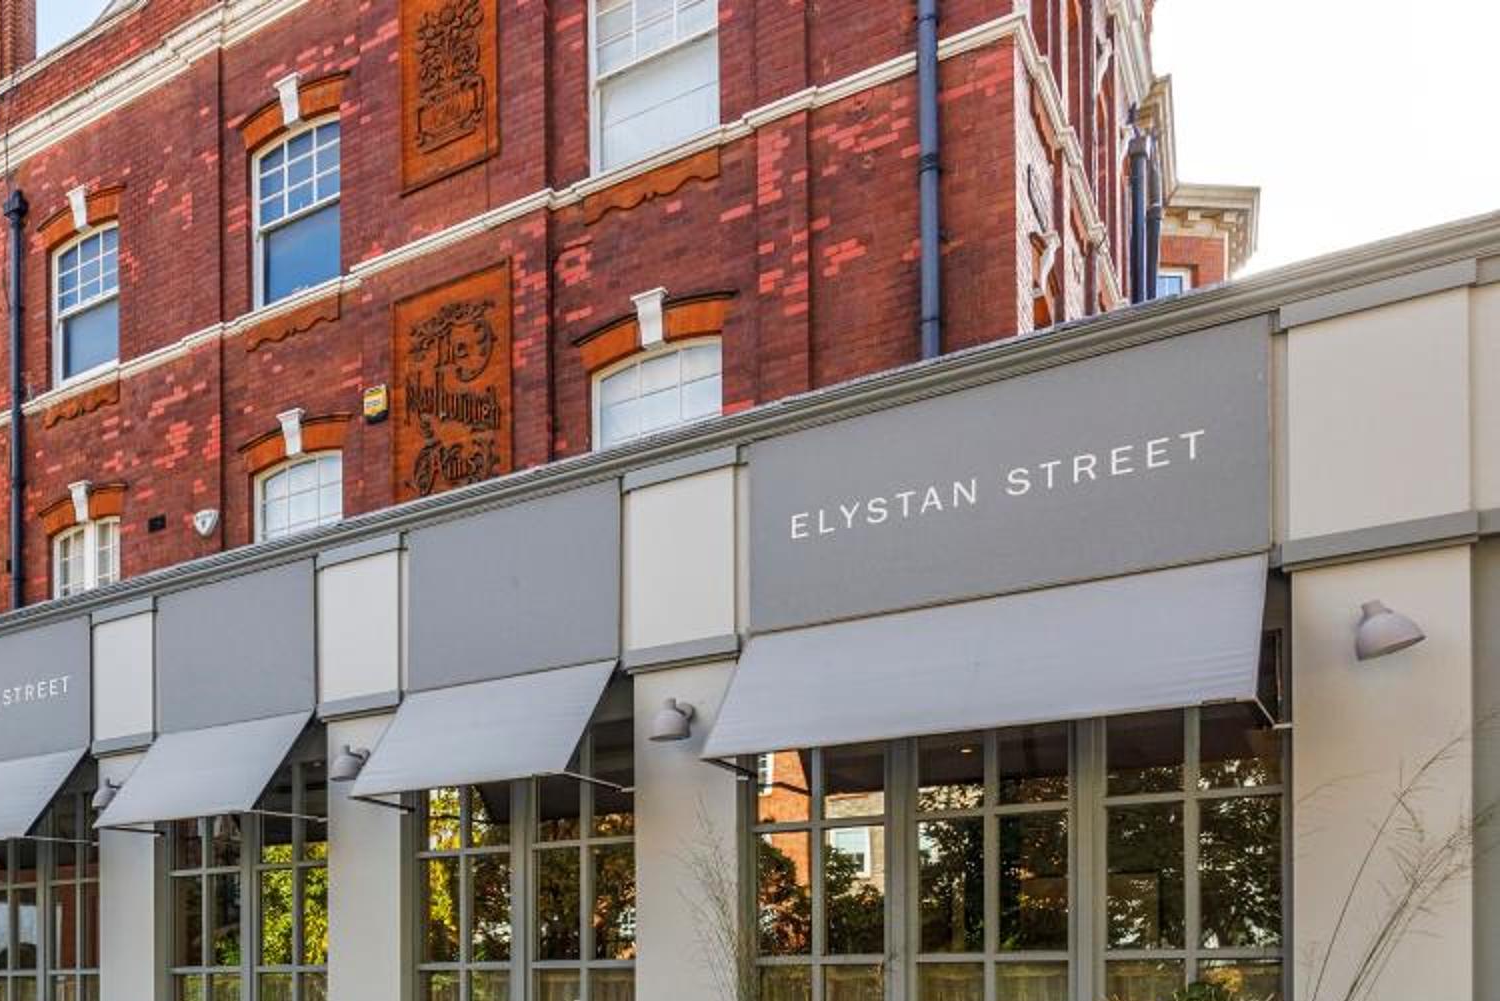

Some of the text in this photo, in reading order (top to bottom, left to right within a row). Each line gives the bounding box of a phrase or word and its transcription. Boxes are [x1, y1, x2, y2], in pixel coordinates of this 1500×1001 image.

[790, 429, 1206, 540] ELYSTAN STREET
[3, 675, 70, 706] STREET
